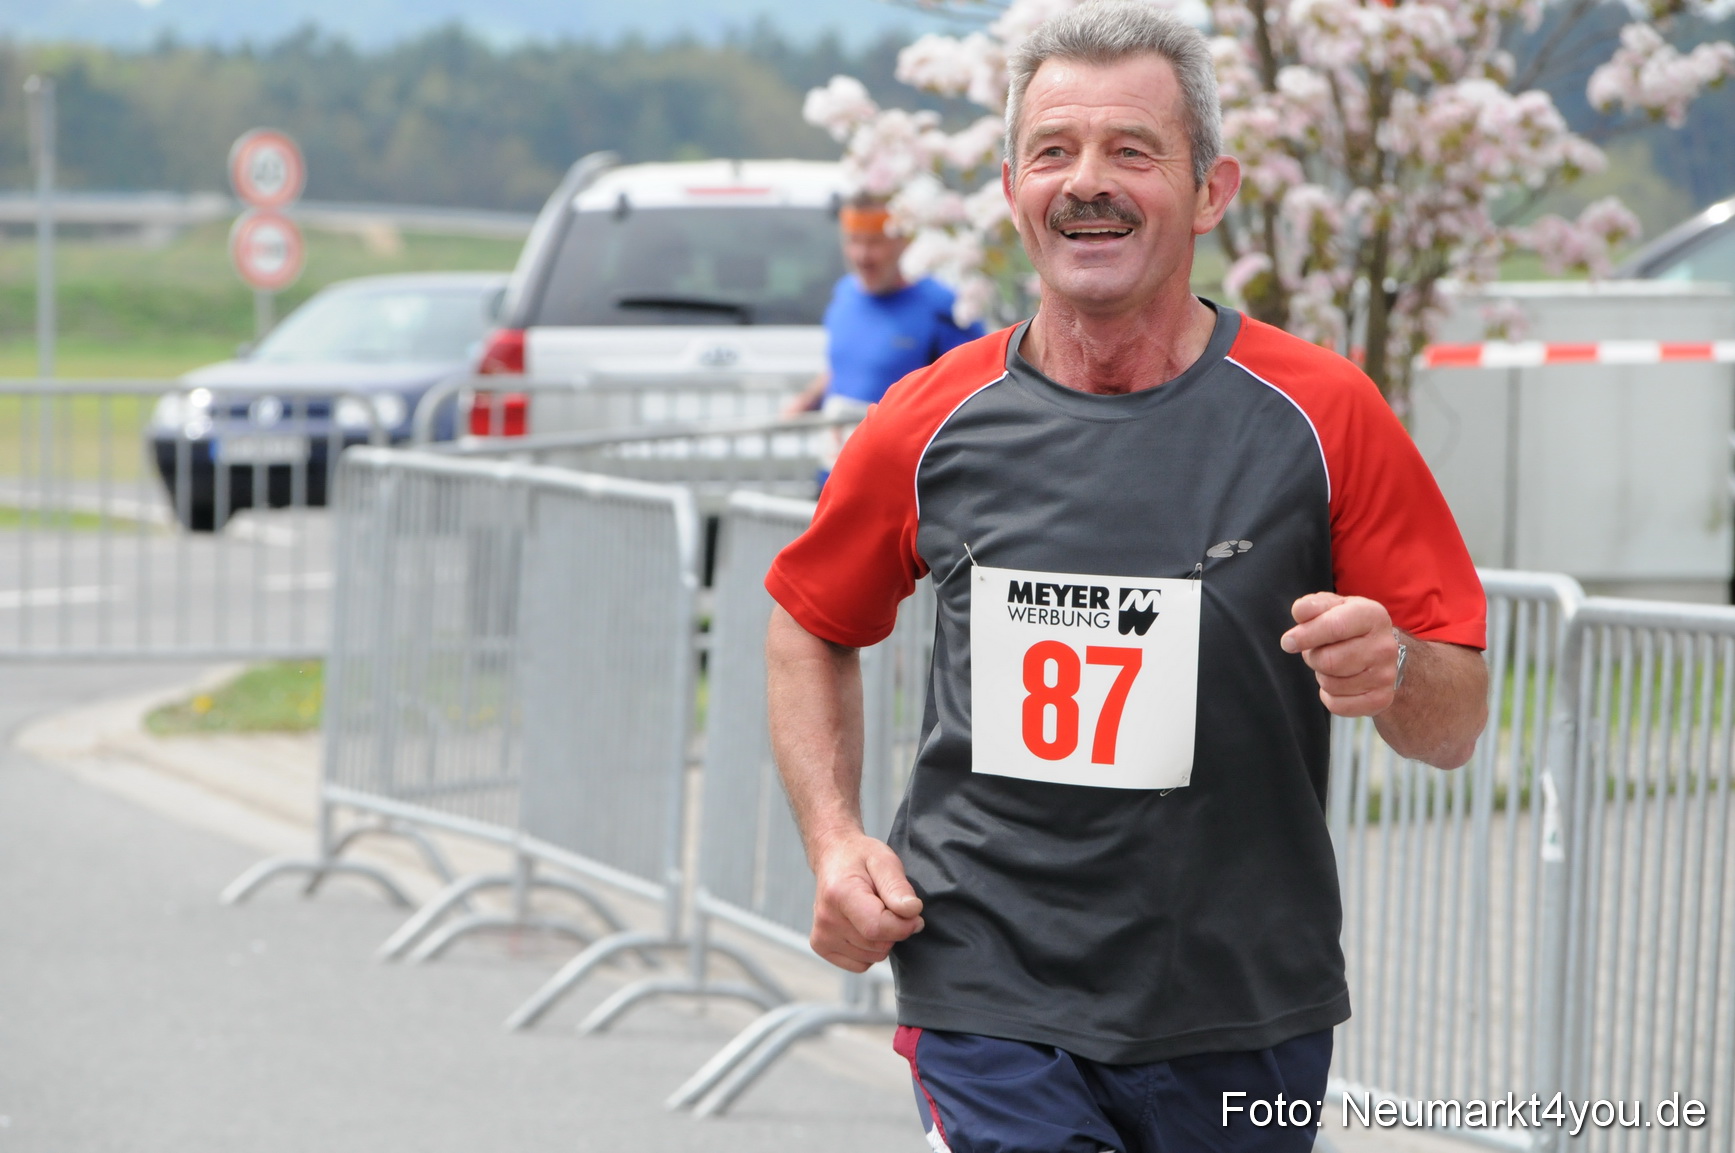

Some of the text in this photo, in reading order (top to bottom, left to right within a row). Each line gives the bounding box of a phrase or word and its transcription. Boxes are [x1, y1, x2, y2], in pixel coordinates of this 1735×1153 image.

[1007, 580, 1110, 610] MEYER
[1007, 605, 1111, 629] WERBUNG
[1022, 640, 1143, 765] 87
